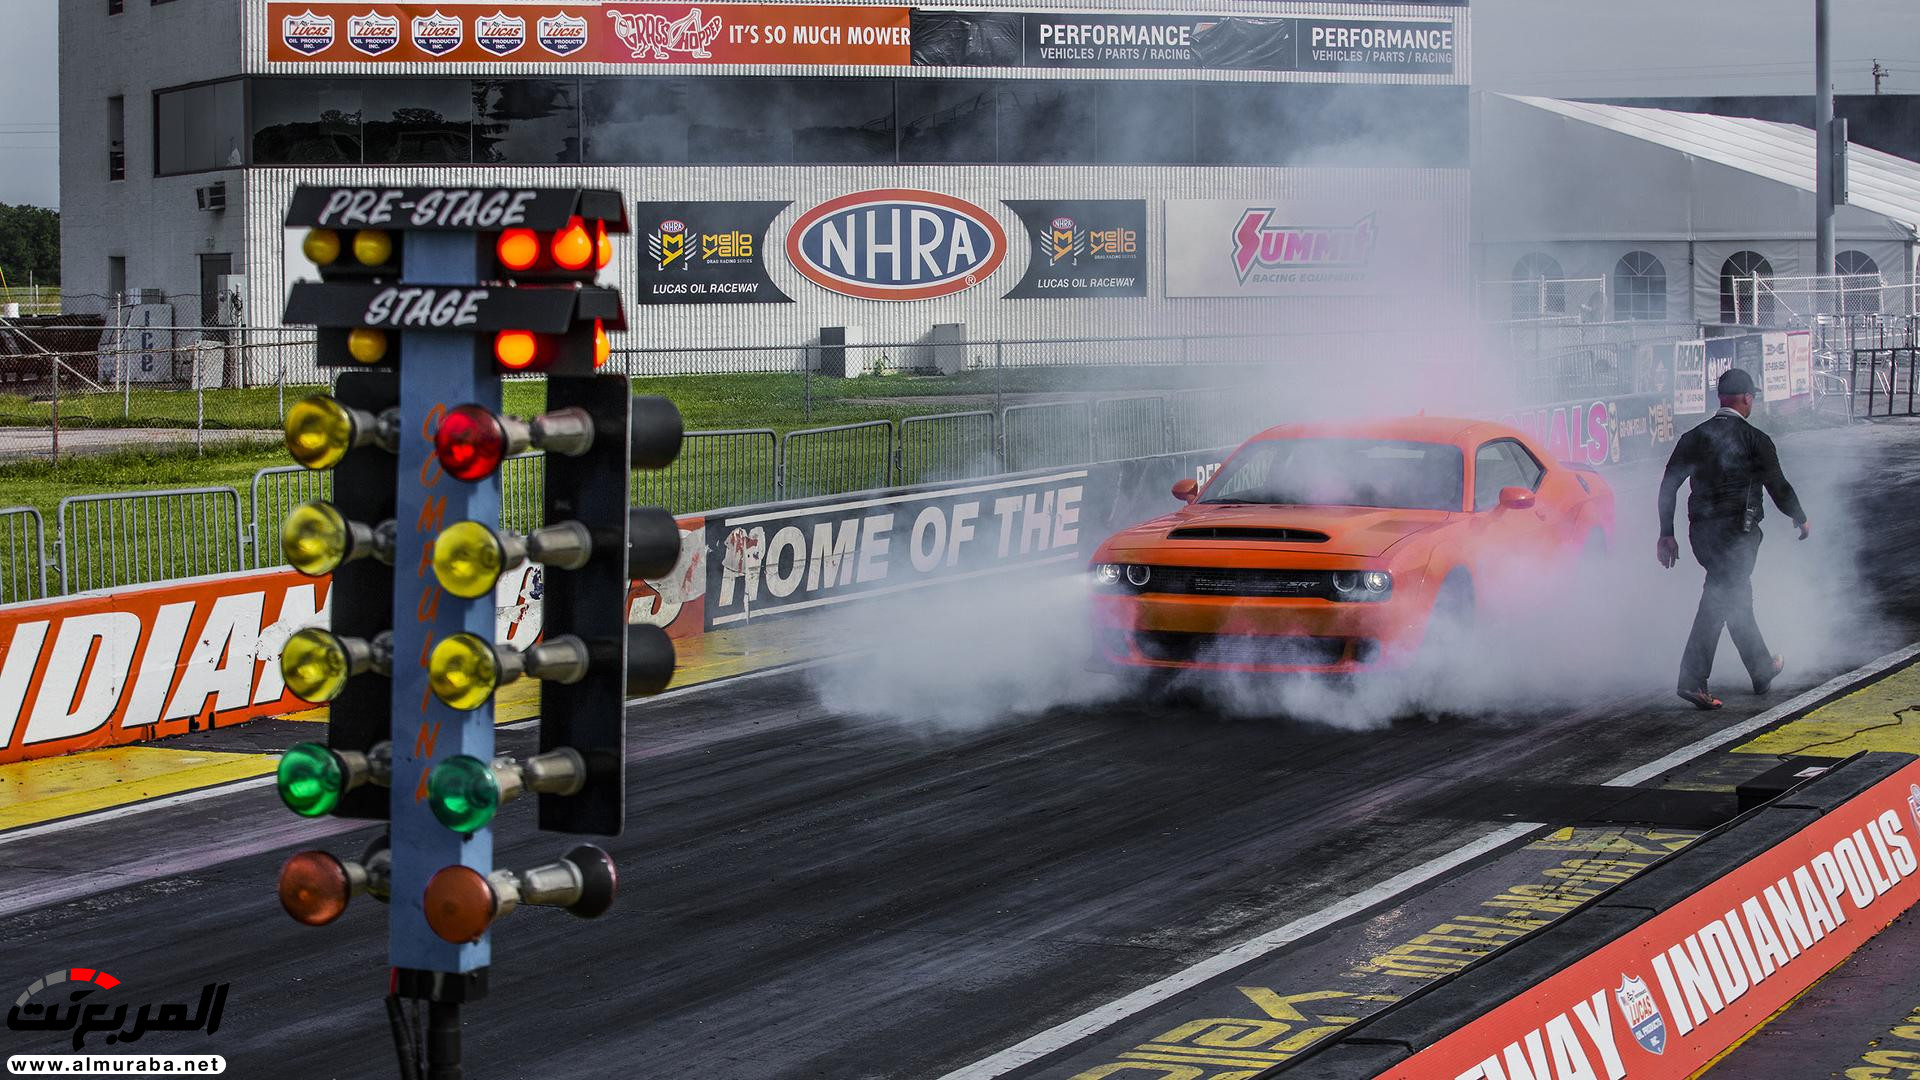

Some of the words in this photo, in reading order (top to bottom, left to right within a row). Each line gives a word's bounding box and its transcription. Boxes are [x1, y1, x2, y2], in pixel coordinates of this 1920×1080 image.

[293, 27, 330, 36] LUCAS
[357, 27, 394, 36] LUCAS
[421, 27, 458, 36] LUCAS
[485, 27, 521, 36] LUCAS
[546, 28, 583, 37] LUCAS
[729, 25, 758, 44] IT'S
[765, 25, 787, 45] SO
[793, 25, 841, 45] MUCH
[847, 25, 911, 46] MOWER
[1039, 24, 1191, 46] PERFORMANCE
[1312, 27, 1453, 49] PERFORMANCE
[1040, 48, 1095, 60] VEHICLES
[1105, 48, 1140, 60] PARTS
[1150, 48, 1191, 60] RACING
[1312, 50, 1363, 62] VEHICLES
[1373, 51, 1405, 63] PARTS
[1415, 52, 1452, 63] RACING
[319, 188, 536, 227] PRE-STAGE
[663, 222, 683, 232] NHRA
[820, 207, 977, 282] NHRA
[1037, 278, 1069, 288] LUCAS
[1071, 278, 1088, 288] OIL
[1090, 277, 1135, 287] RACEWAY
[1252, 273, 1296, 283] RACING
[653, 284, 688, 294] LUCAS
[690, 283, 707, 293] OIL
[710, 283, 759, 293] RACEWAY
[364, 288, 489, 328] STAGE
[909, 502, 981, 574] OF
[993, 485, 1084, 558] THE
[1286, 581, 1320, 589] SRT
[1651, 809, 1918, 1037] INDIANAPOLIS
[1629, 995, 1653, 1026] LUCAS
